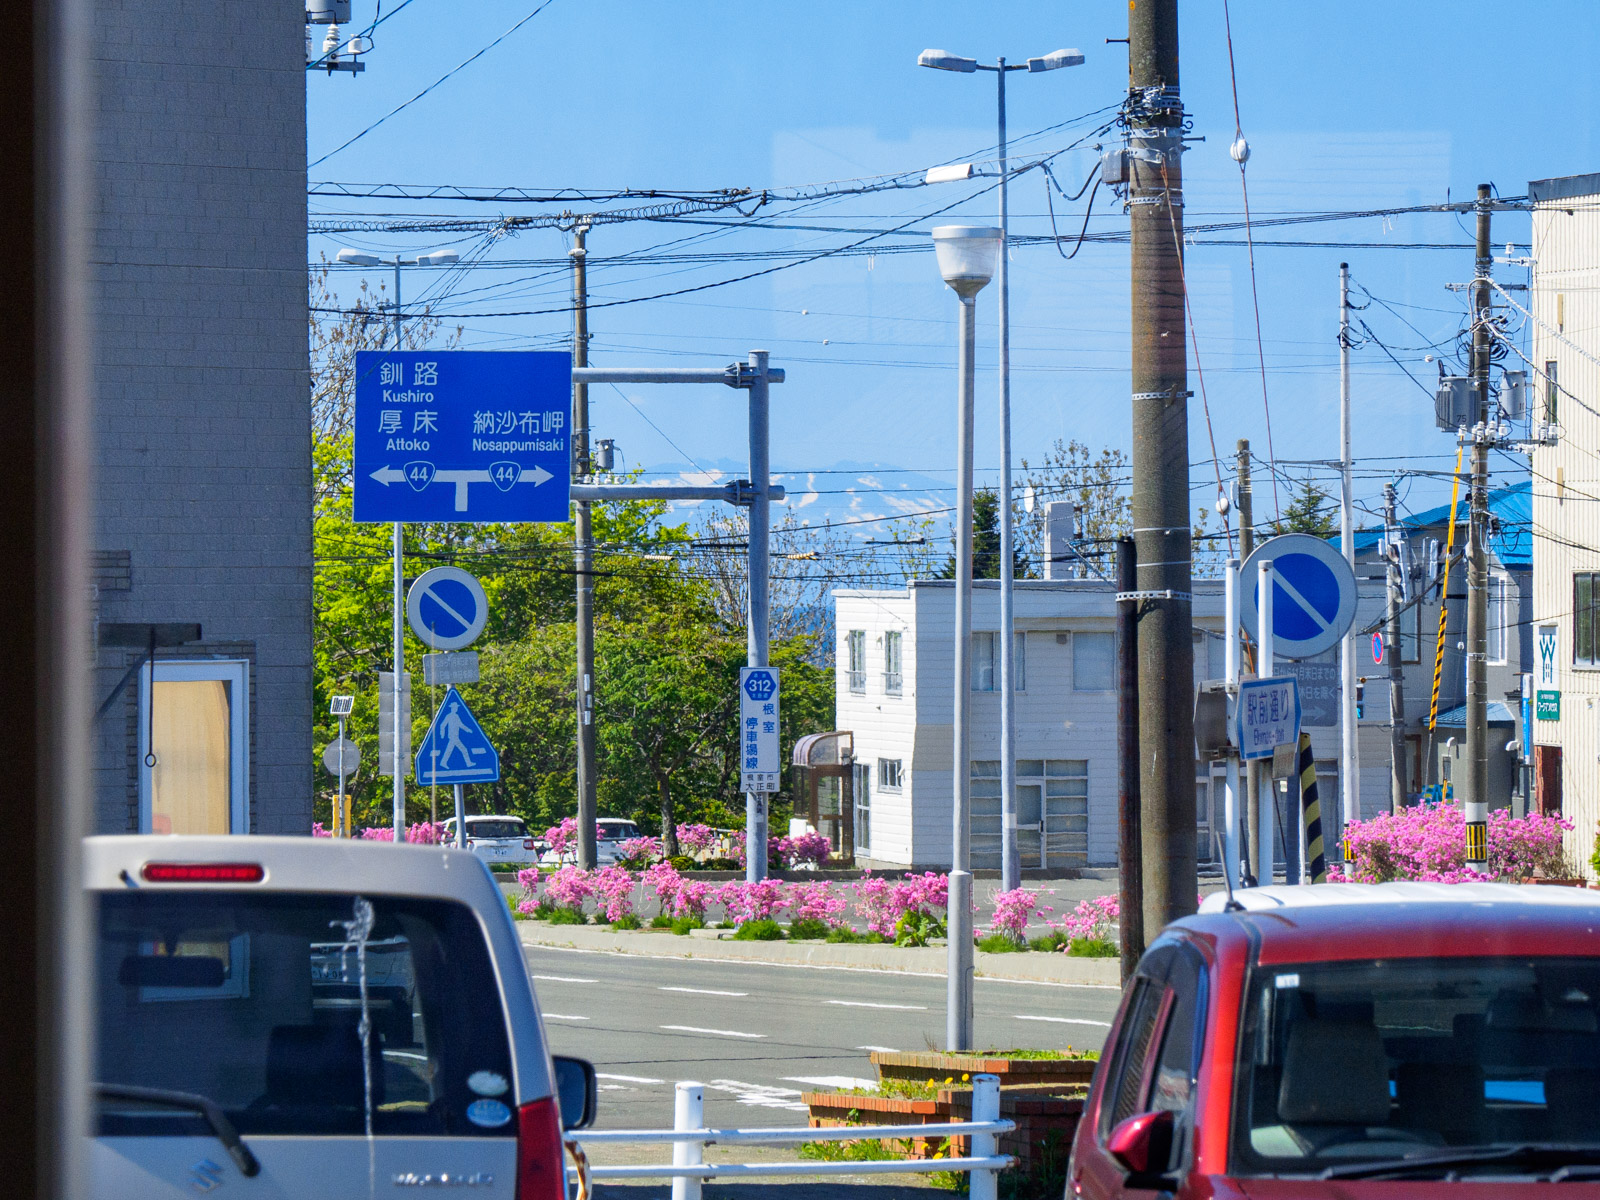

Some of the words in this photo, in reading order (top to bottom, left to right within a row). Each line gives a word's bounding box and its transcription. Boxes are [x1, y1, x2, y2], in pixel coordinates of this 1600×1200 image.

[380, 361, 438, 386] 釧路
[382, 389, 434, 403] Kushiro
[378, 409, 438, 434] 厚床
[473, 410, 564, 435] 納沙布岬
[1457, 414, 1467, 423] 75
[386, 438, 430, 451] Attoko
[472, 438, 564, 454] Nosappumisaki
[409, 466, 428, 482] 44
[495, 466, 514, 482] 44
[748, 679, 771, 692] 312
[762, 703, 775, 734] 根室
[745, 716, 759, 769] 停車場線
[745, 782, 775, 791] 大正町
